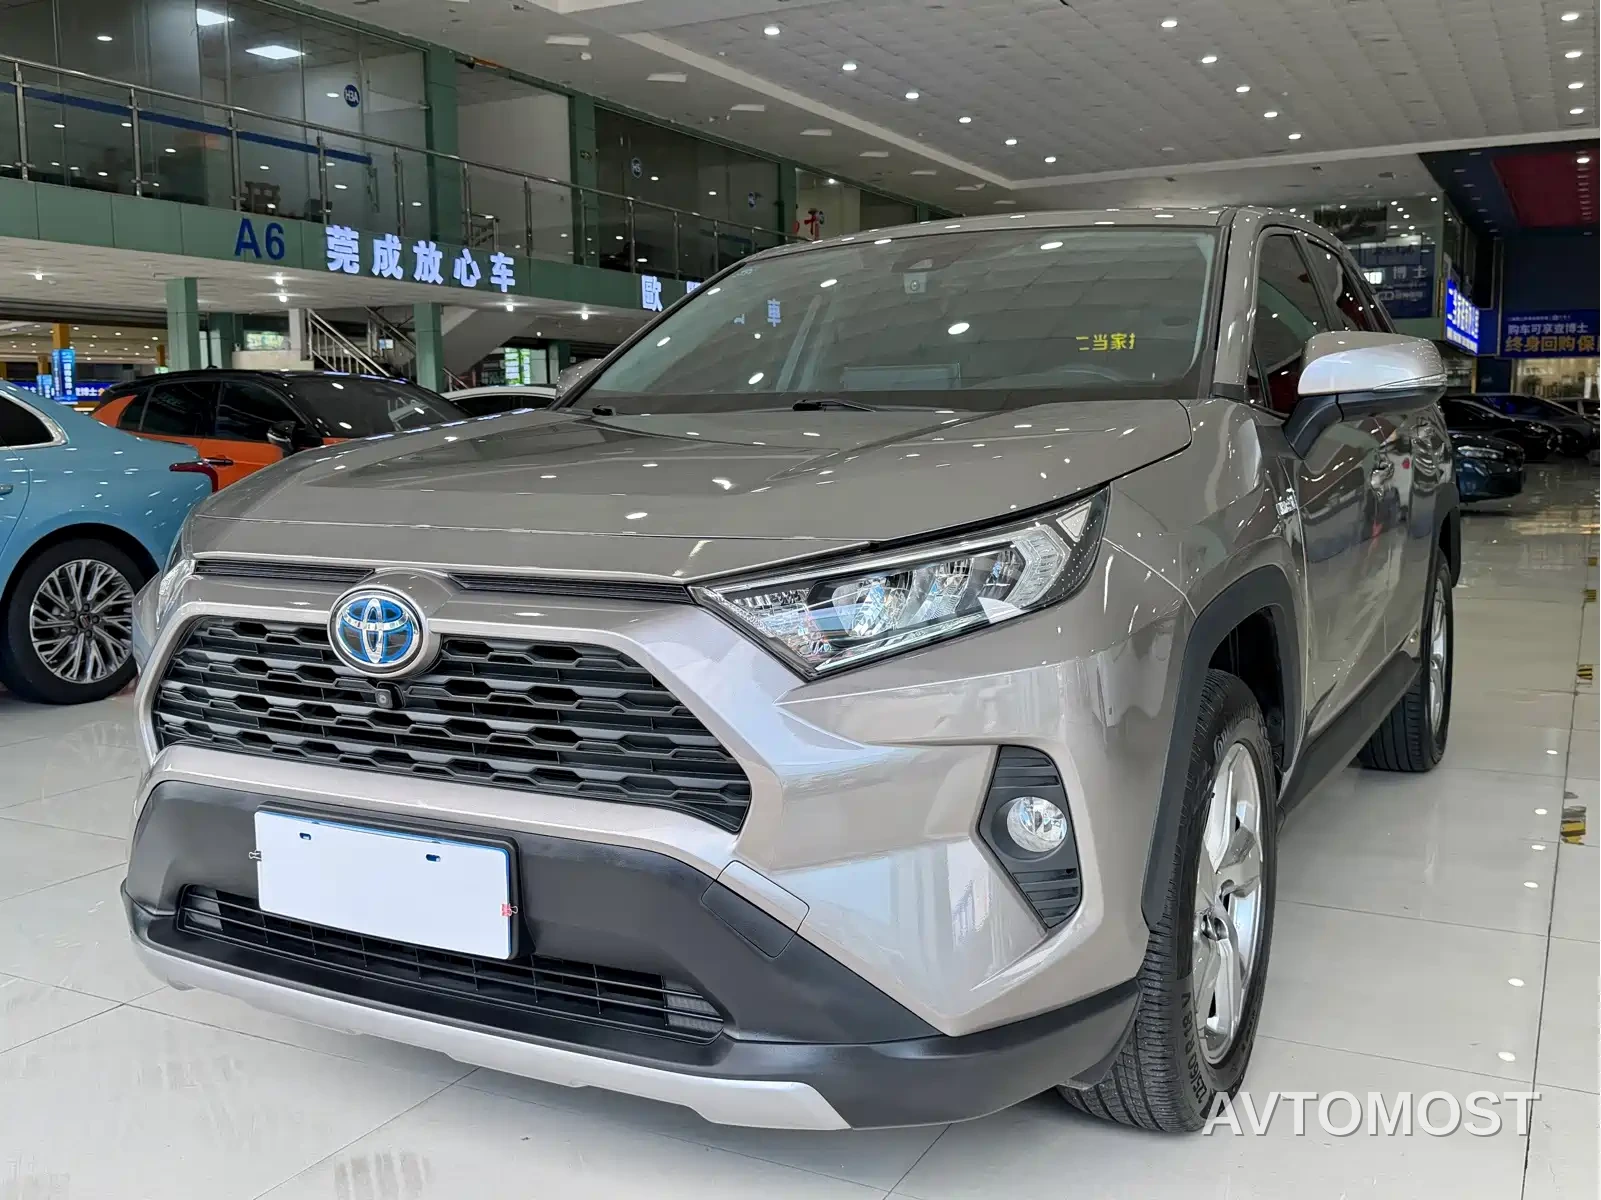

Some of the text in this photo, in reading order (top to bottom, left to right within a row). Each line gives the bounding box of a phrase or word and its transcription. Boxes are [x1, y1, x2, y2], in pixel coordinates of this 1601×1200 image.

[234, 217, 285, 260] A6
[325, 224, 516, 293] 莞成放心车
[1505, 335, 1600, 353] 终身回购保
[1187, 1054, 1208, 1104] 225/60
